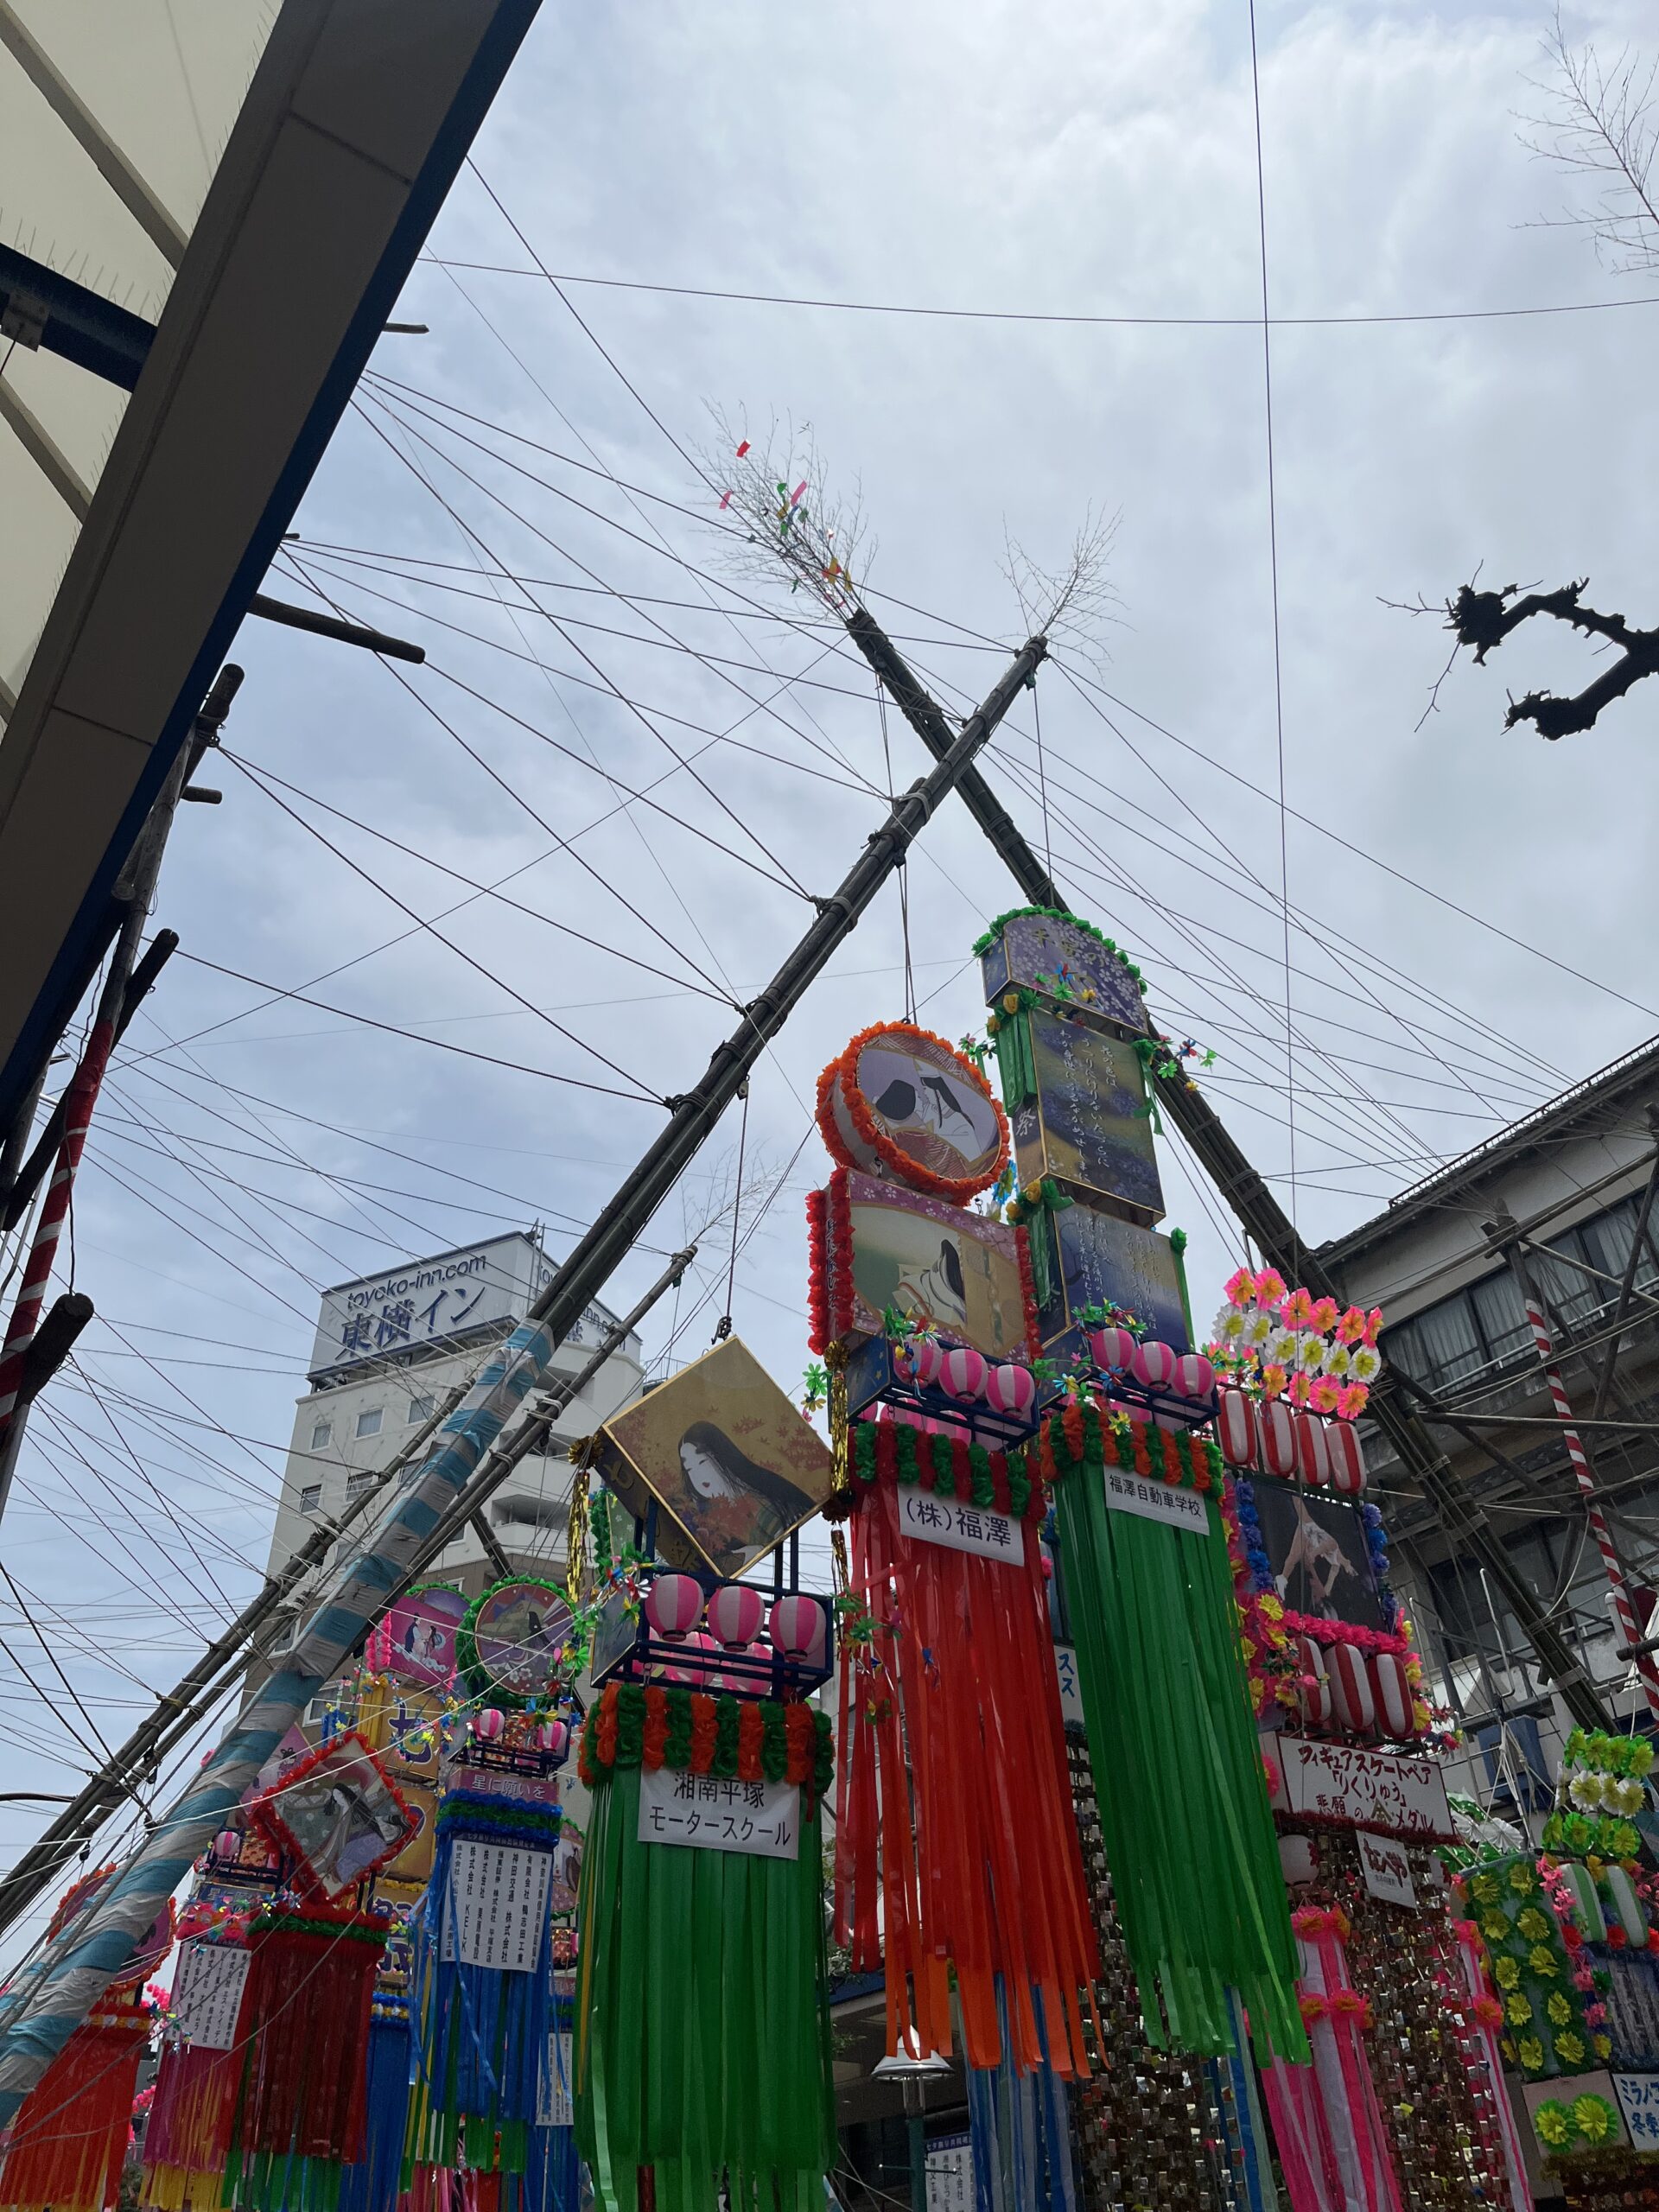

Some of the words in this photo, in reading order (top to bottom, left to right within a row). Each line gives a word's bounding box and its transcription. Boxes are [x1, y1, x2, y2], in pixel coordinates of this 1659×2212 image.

[347, 1253, 486, 1310] toyoko-inn.com
[334, 1286, 486, 1361] 東横イン
[1109, 1474, 1202, 1518] 福澤自動車学校
[1298, 1745, 1431, 1785] フィギュアスケートペア
[472, 1774, 545, 1798] 星に願いを
[674, 1771, 765, 1808] 湘南平塚
[650, 1806, 791, 1847] モータースクール
